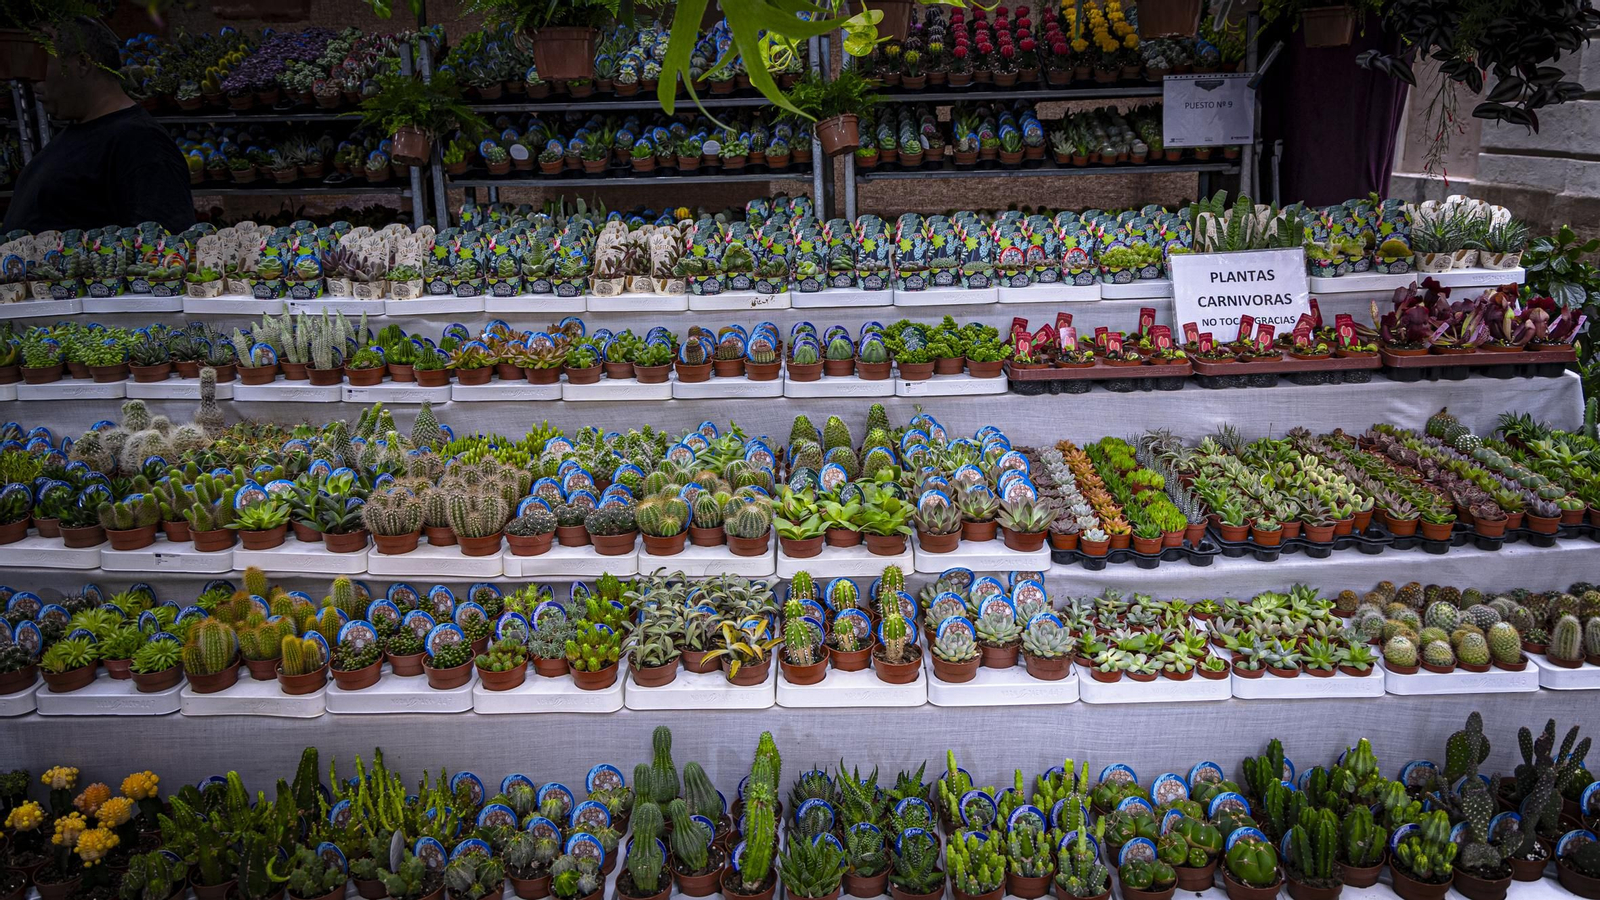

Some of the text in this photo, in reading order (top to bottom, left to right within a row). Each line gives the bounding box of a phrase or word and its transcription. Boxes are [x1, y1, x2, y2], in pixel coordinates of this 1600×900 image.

[1184, 101, 1214, 109] PUESTO
[1210, 269, 1275, 283] PLANTAS
[1198, 293, 1292, 308] CARNIVORAS
[1202, 316, 1296, 326] NO TOC GRACIAS
